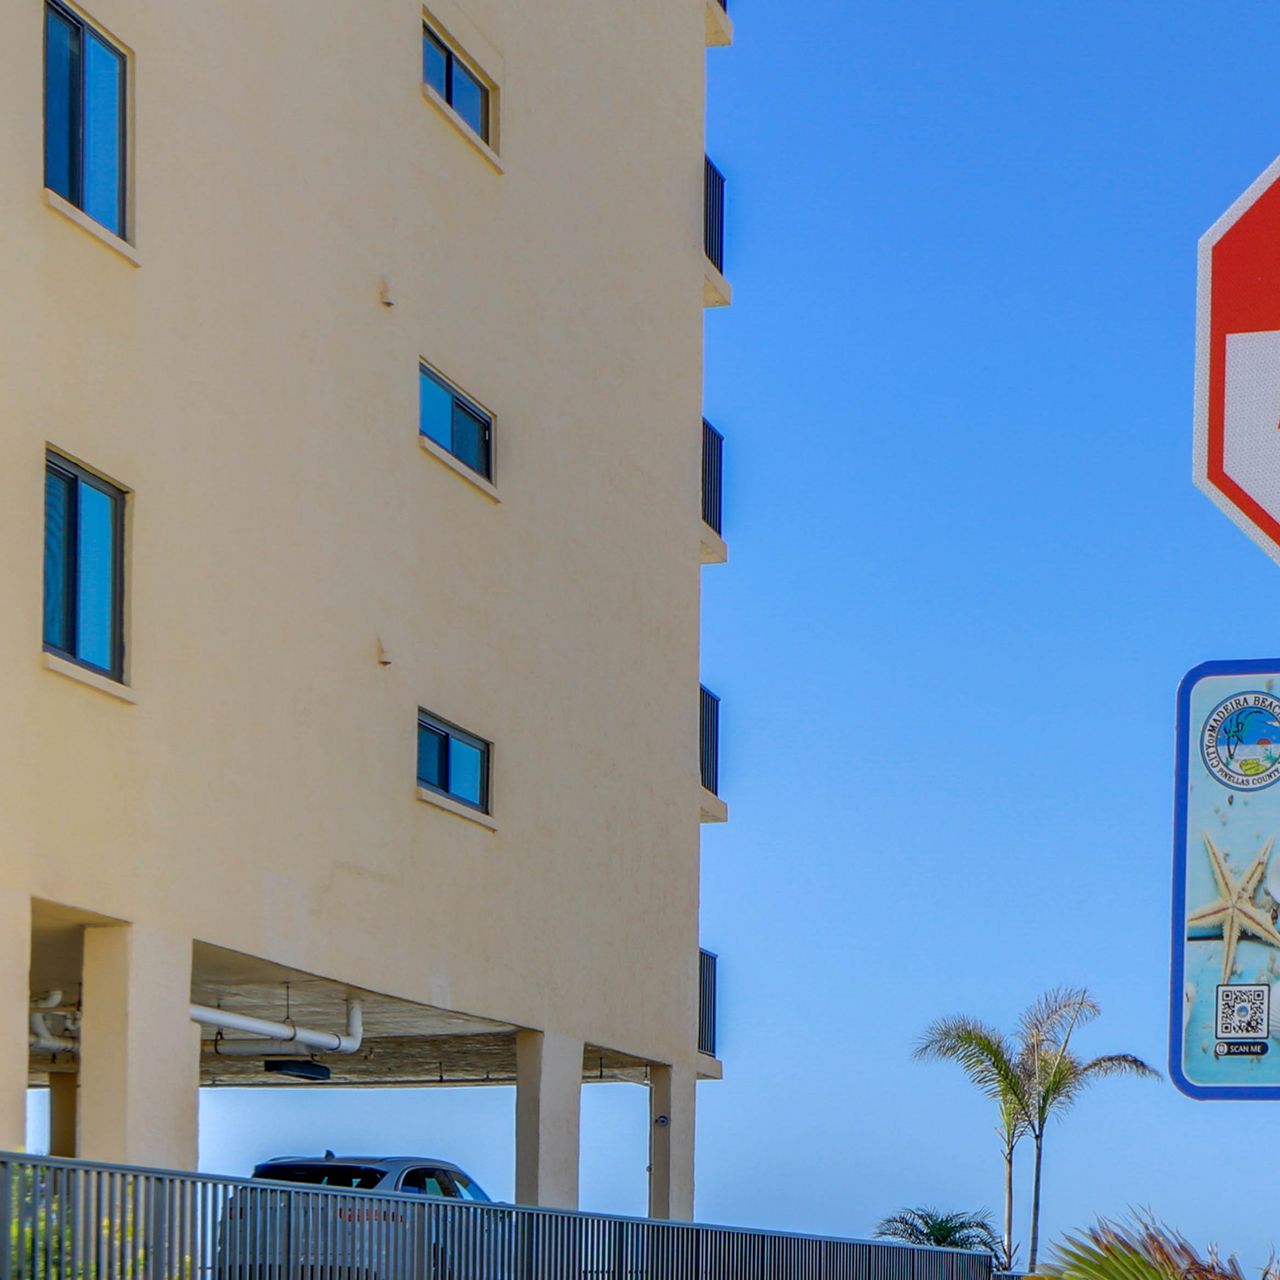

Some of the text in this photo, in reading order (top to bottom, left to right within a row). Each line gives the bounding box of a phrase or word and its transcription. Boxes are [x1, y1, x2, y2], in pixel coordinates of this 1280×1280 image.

[1207, 696, 1249, 733] MADEIRA
[1251, 767, 1280, 786] COUNTY
[1229, 1045, 1262, 1054] SCAN ME
